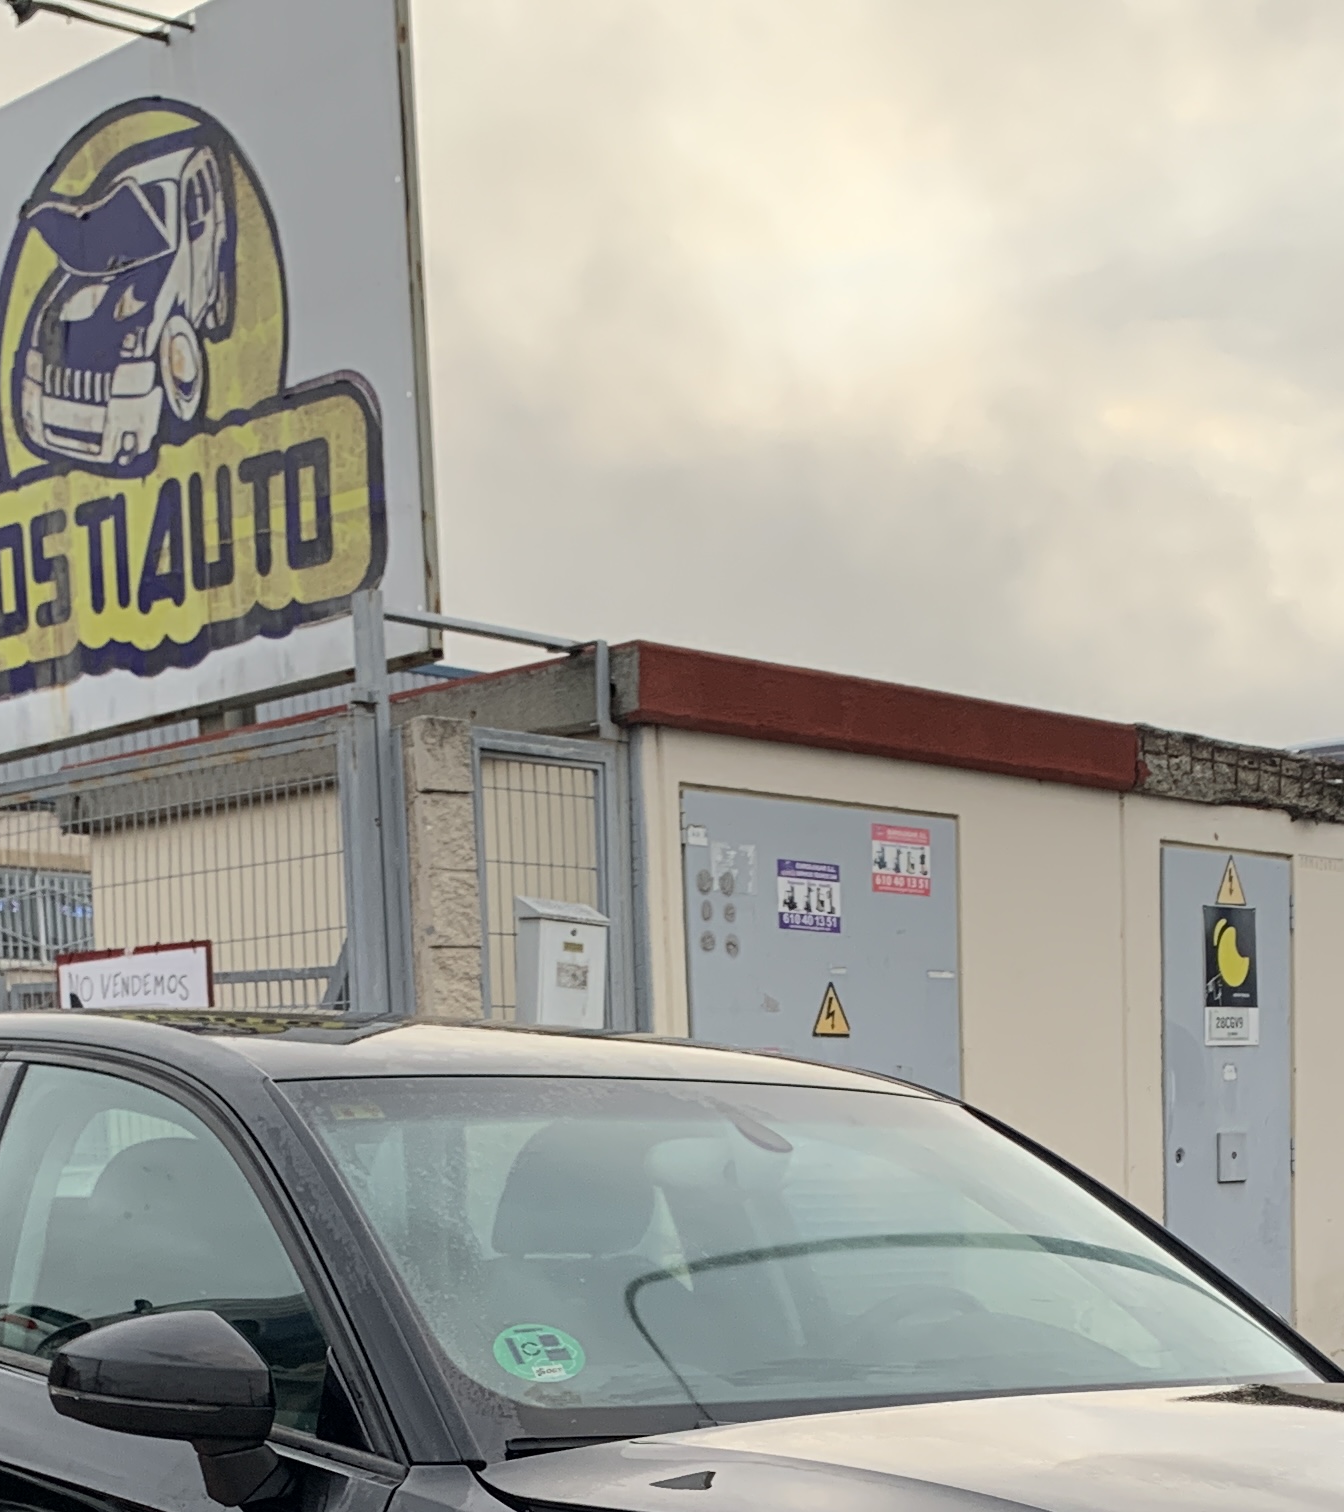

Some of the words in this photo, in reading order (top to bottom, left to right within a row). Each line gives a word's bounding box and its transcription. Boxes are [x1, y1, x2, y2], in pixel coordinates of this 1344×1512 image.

[783, 913, 801, 924] 610
[802, 914, 814, 926] 40
[815, 916, 825, 927] 13
[826, 917, 837, 928] 51
[68, 972, 94, 1002] NO
[100, 972, 190, 1001] VENDEMOS
